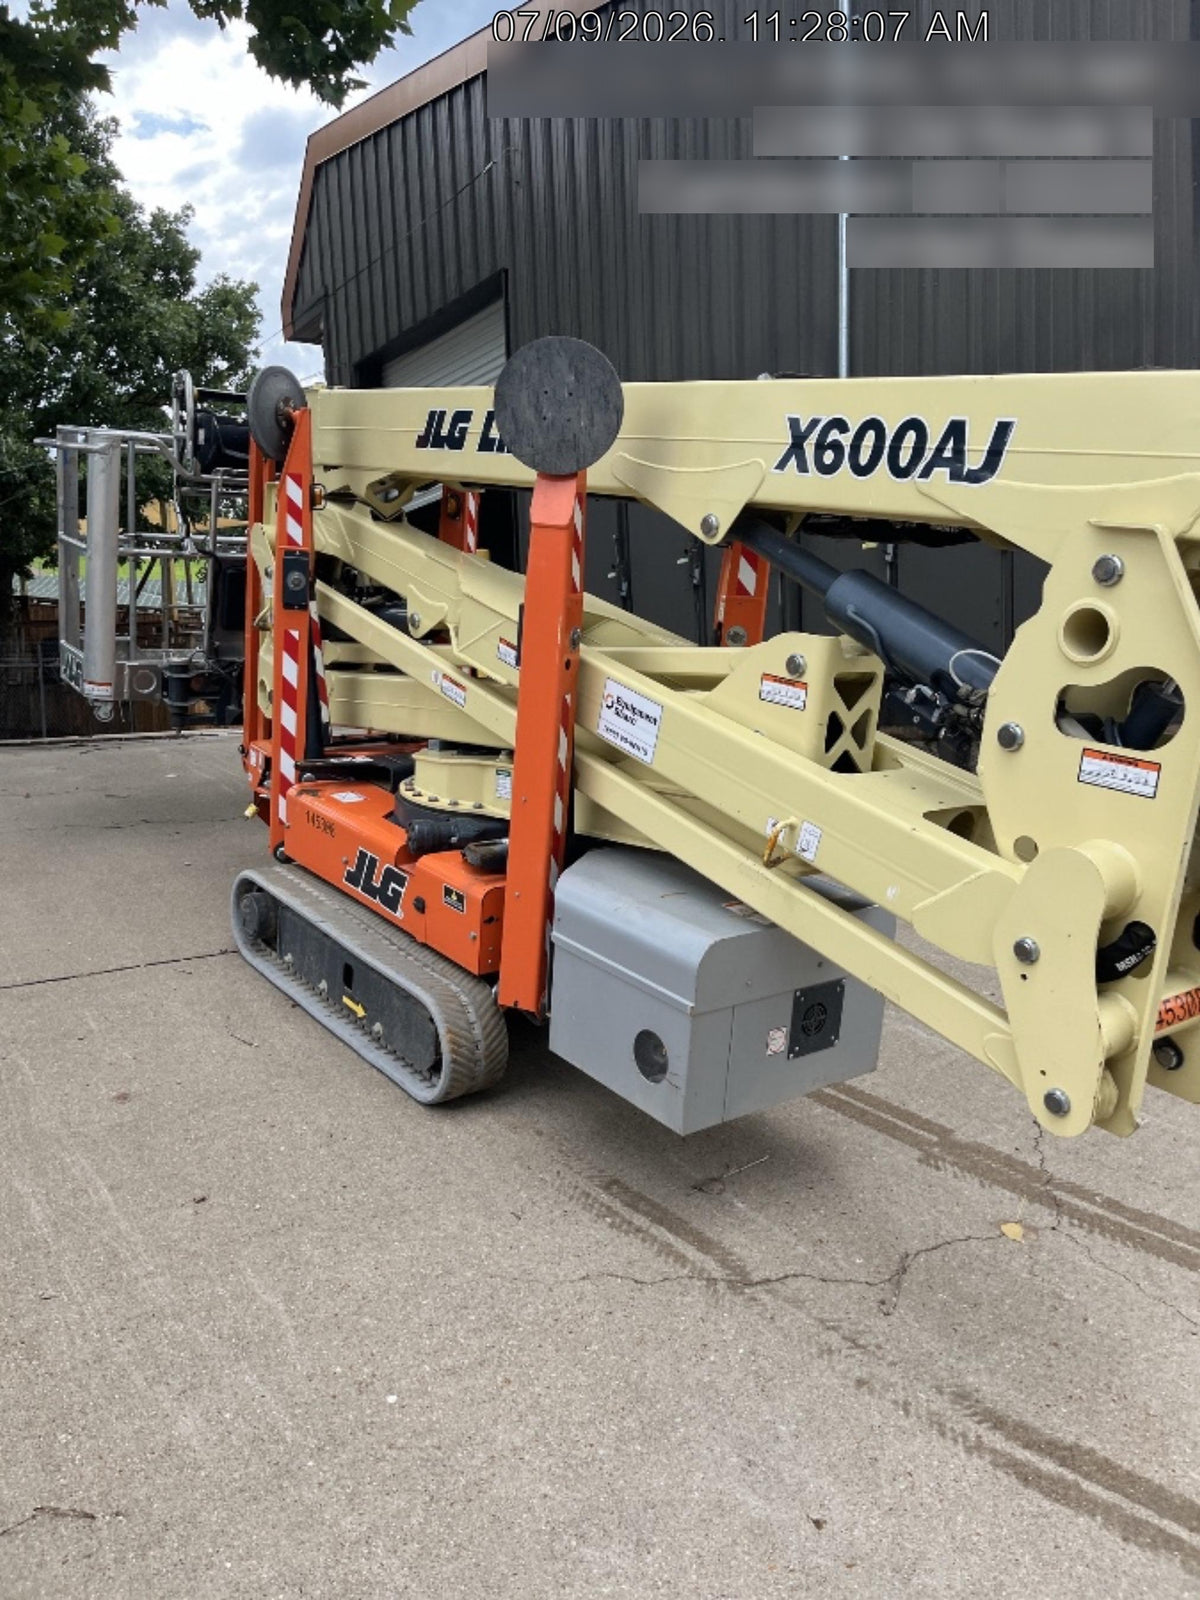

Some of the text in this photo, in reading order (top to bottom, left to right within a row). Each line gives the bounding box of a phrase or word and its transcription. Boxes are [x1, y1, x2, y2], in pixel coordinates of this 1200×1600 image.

[415, 408, 475, 452] JLG
[772, 414, 1018, 487] X600AJ
[343, 846, 409, 914] JLG
